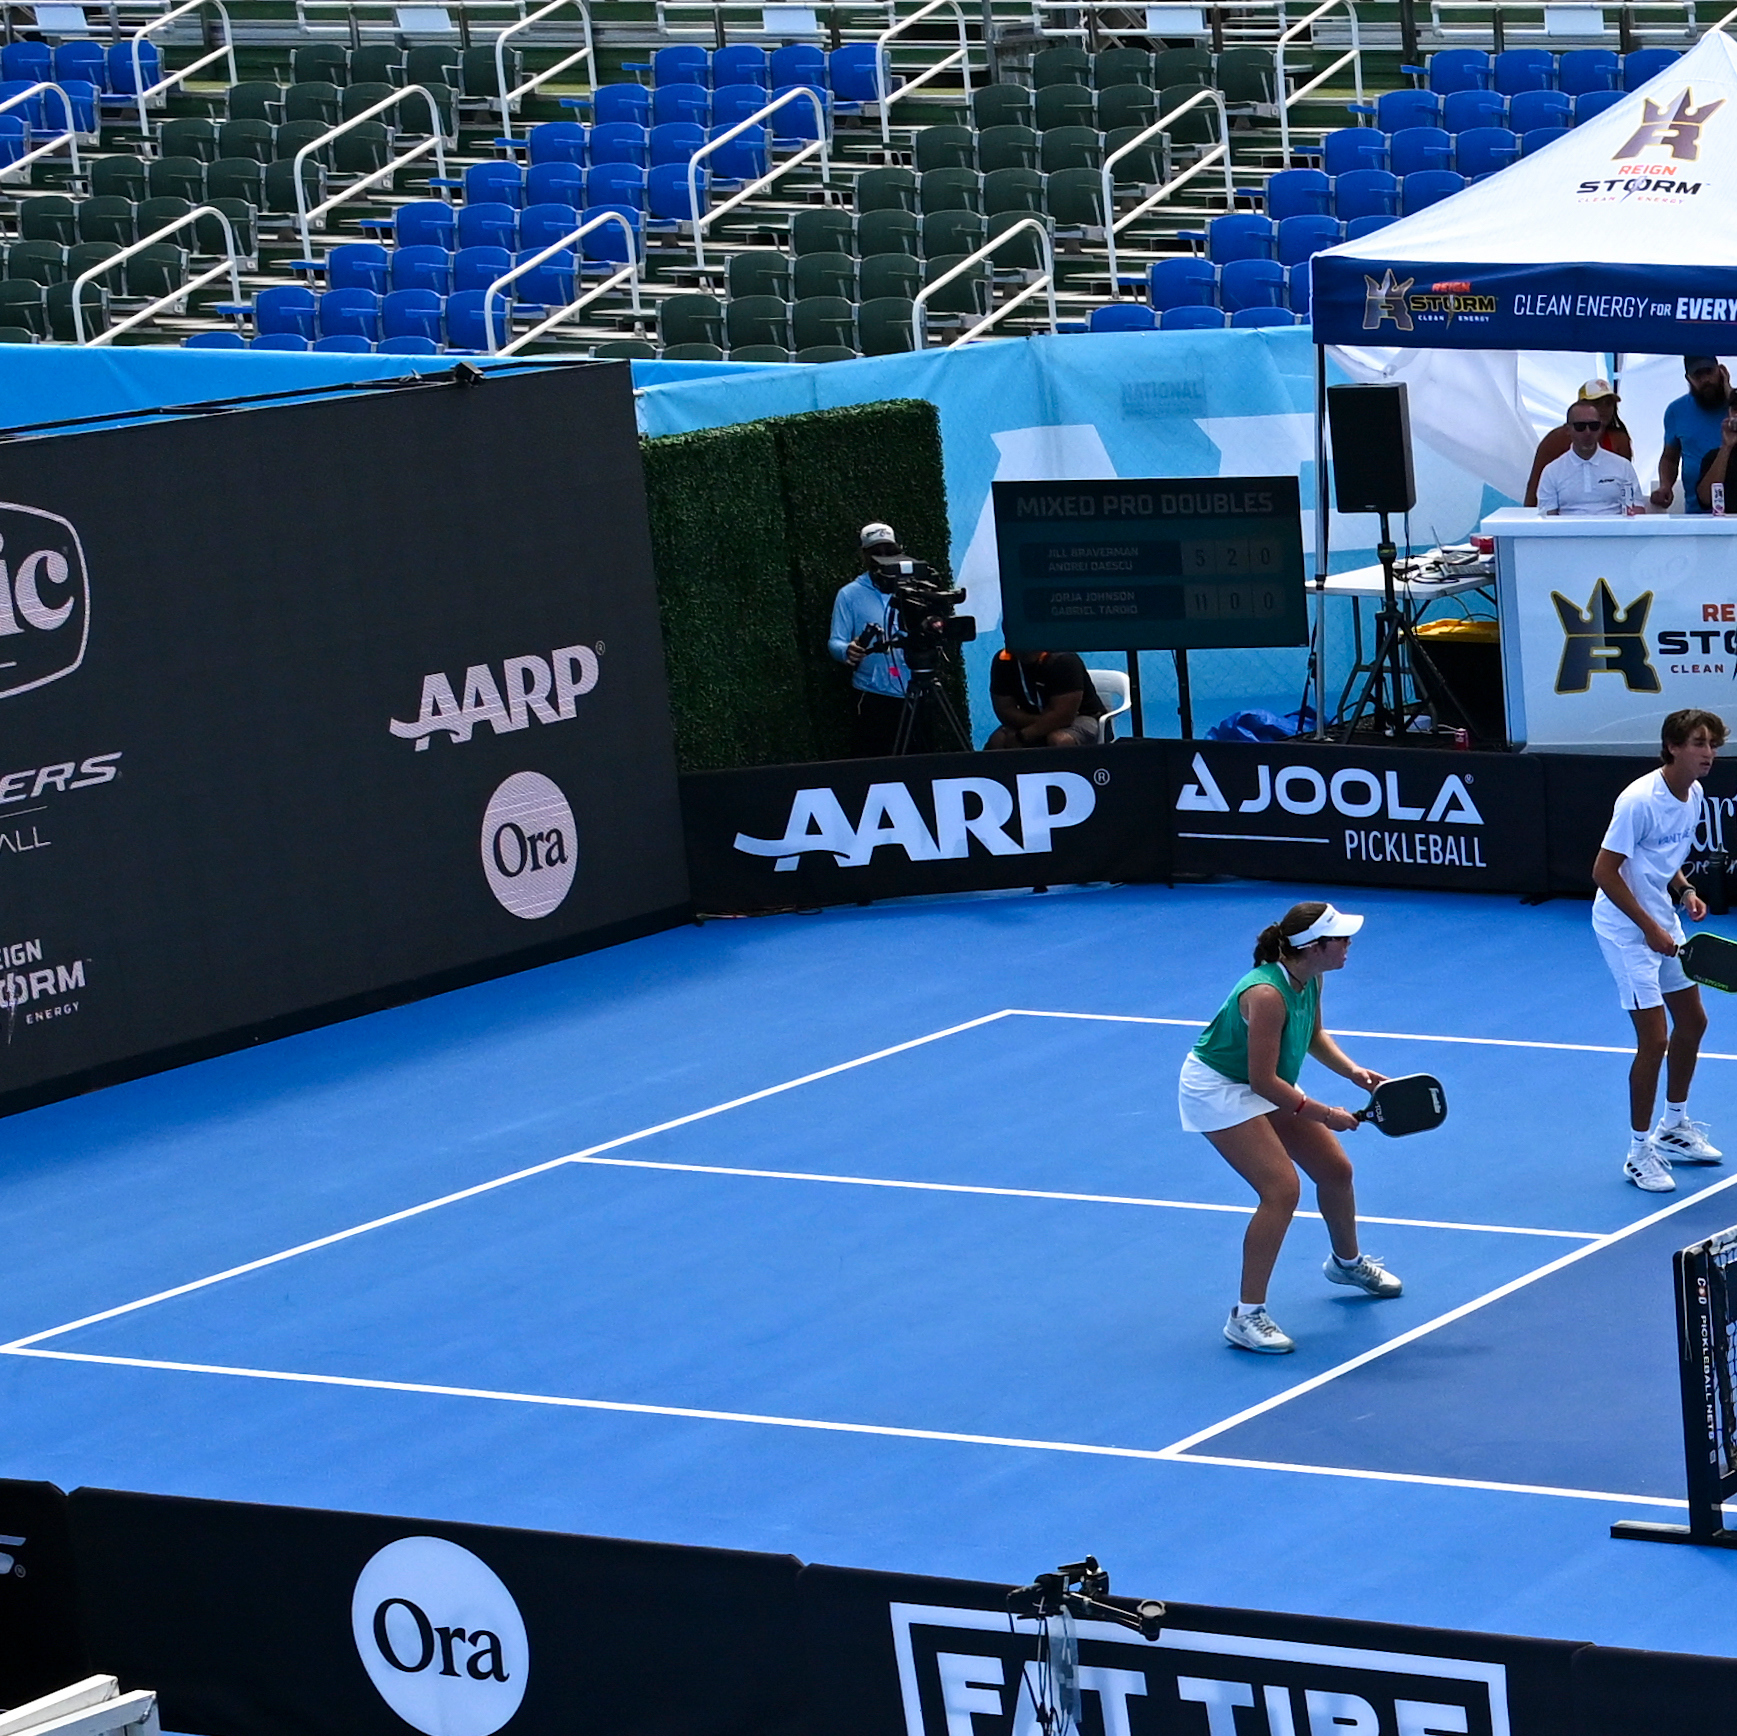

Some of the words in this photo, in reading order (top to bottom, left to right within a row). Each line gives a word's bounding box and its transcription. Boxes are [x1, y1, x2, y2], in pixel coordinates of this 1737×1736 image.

[1619, 164, 1678, 176] REIGN
[1577, 177, 1703, 196] STORM
[1513, 293, 1572, 317] CLEAN
[1576, 294, 1650, 320] ENERGY
[1650, 300, 1672, 318] FOR
[1016, 495, 1095, 517] MIXED
[1103, 494, 1153, 516] PRO
[1162, 492, 1274, 515] DOUBLES
[1195, 548, 1206, 568] 5
[1227, 547, 1238, 567] 2
[1260, 546, 1270, 566] 0
[1230, 593, 1240, 611] 0
[1264, 592, 1274, 611] 0
[1671, 663, 1724, 674] CLEAN
[389, 645, 601, 752] AARP
[1237, 765, 1485, 825] JOOLA
[733, 771, 1097, 872] AARP
[494, 821, 568, 879] Ora
[1345, 829, 1488, 868] PICKLEBALL
[26, 1001, 80, 1025] ENERGY
[1700, 1314, 1710, 1402] PICKLEBALL
[372, 1597, 510, 1683] Ora
